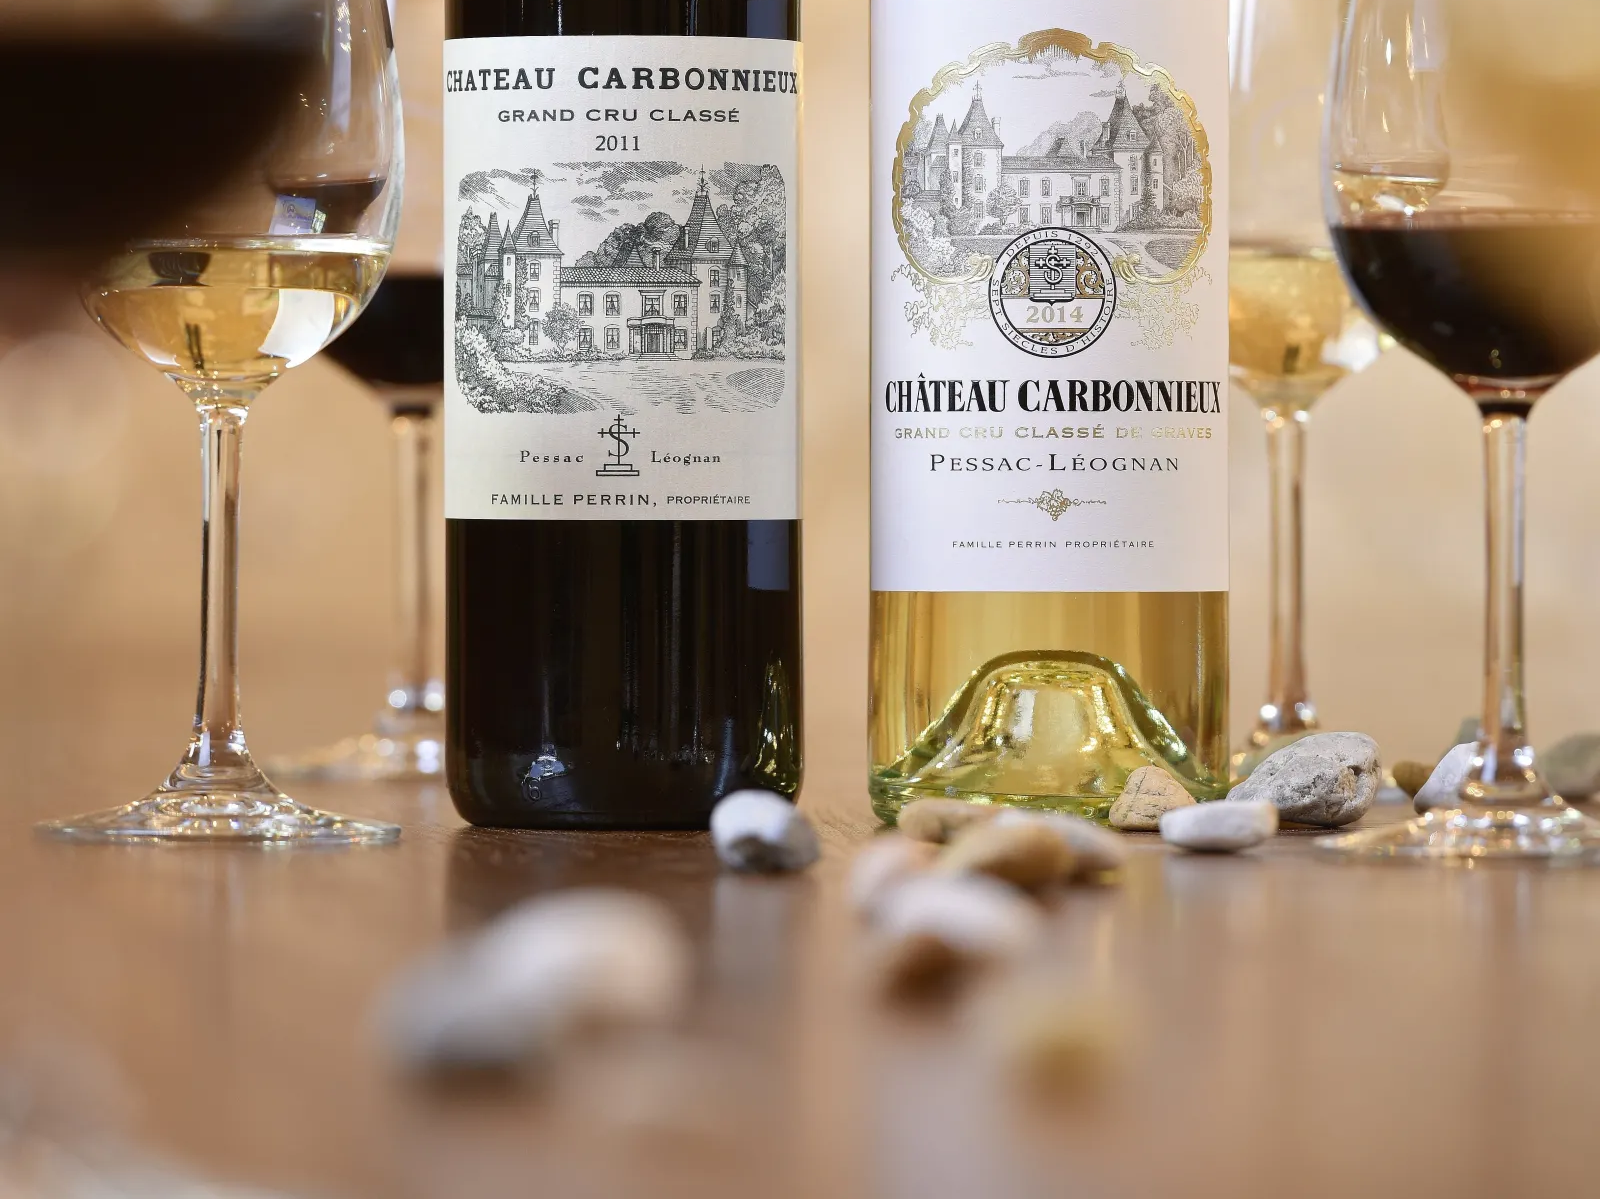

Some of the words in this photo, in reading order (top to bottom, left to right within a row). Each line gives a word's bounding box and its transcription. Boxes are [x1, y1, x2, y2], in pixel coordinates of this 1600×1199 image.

[446, 67, 556, 93] CHATEAU
[577, 66, 798, 95] CARBONNIEUX
[498, 109, 575, 123] GRAND
[585, 108, 638, 122] CRU
[649, 106, 741, 123] CLASSÉ
[594, 135, 641, 152] 2011
[1006, 230, 1059, 258] DEPUIS
[1067, 233, 1099, 257] 1292
[991, 278, 1004, 317] SEPT
[1025, 305, 1084, 323] 2014
[885, 372, 1010, 413] CHÂTEAU
[1017, 379, 1221, 414] CARBONNIEUX
[894, 427, 950, 440] GRAND
[958, 426, 1004, 439] CRU
[1014, 423, 1105, 439] CLASSÉ
[1115, 426, 1144, 440] DE
[1150, 426, 1213, 440] GRAVES
[519, 450, 585, 464] Pessac
[650, 450, 722, 467] Léognan
[929, 453, 1179, 472] PESSAC-LÉOGNAN
[491, 493, 564, 506] FAMILLE
[572, 493, 658, 508] PERRIN,
[666, 493, 751, 505] PROPRIÉTAIRE
[951, 540, 1003, 549] FAMILLE
[1008, 540, 1057, 549] PERRIN
[1065, 539, 1155, 549] PROPRIÉTAIRE
